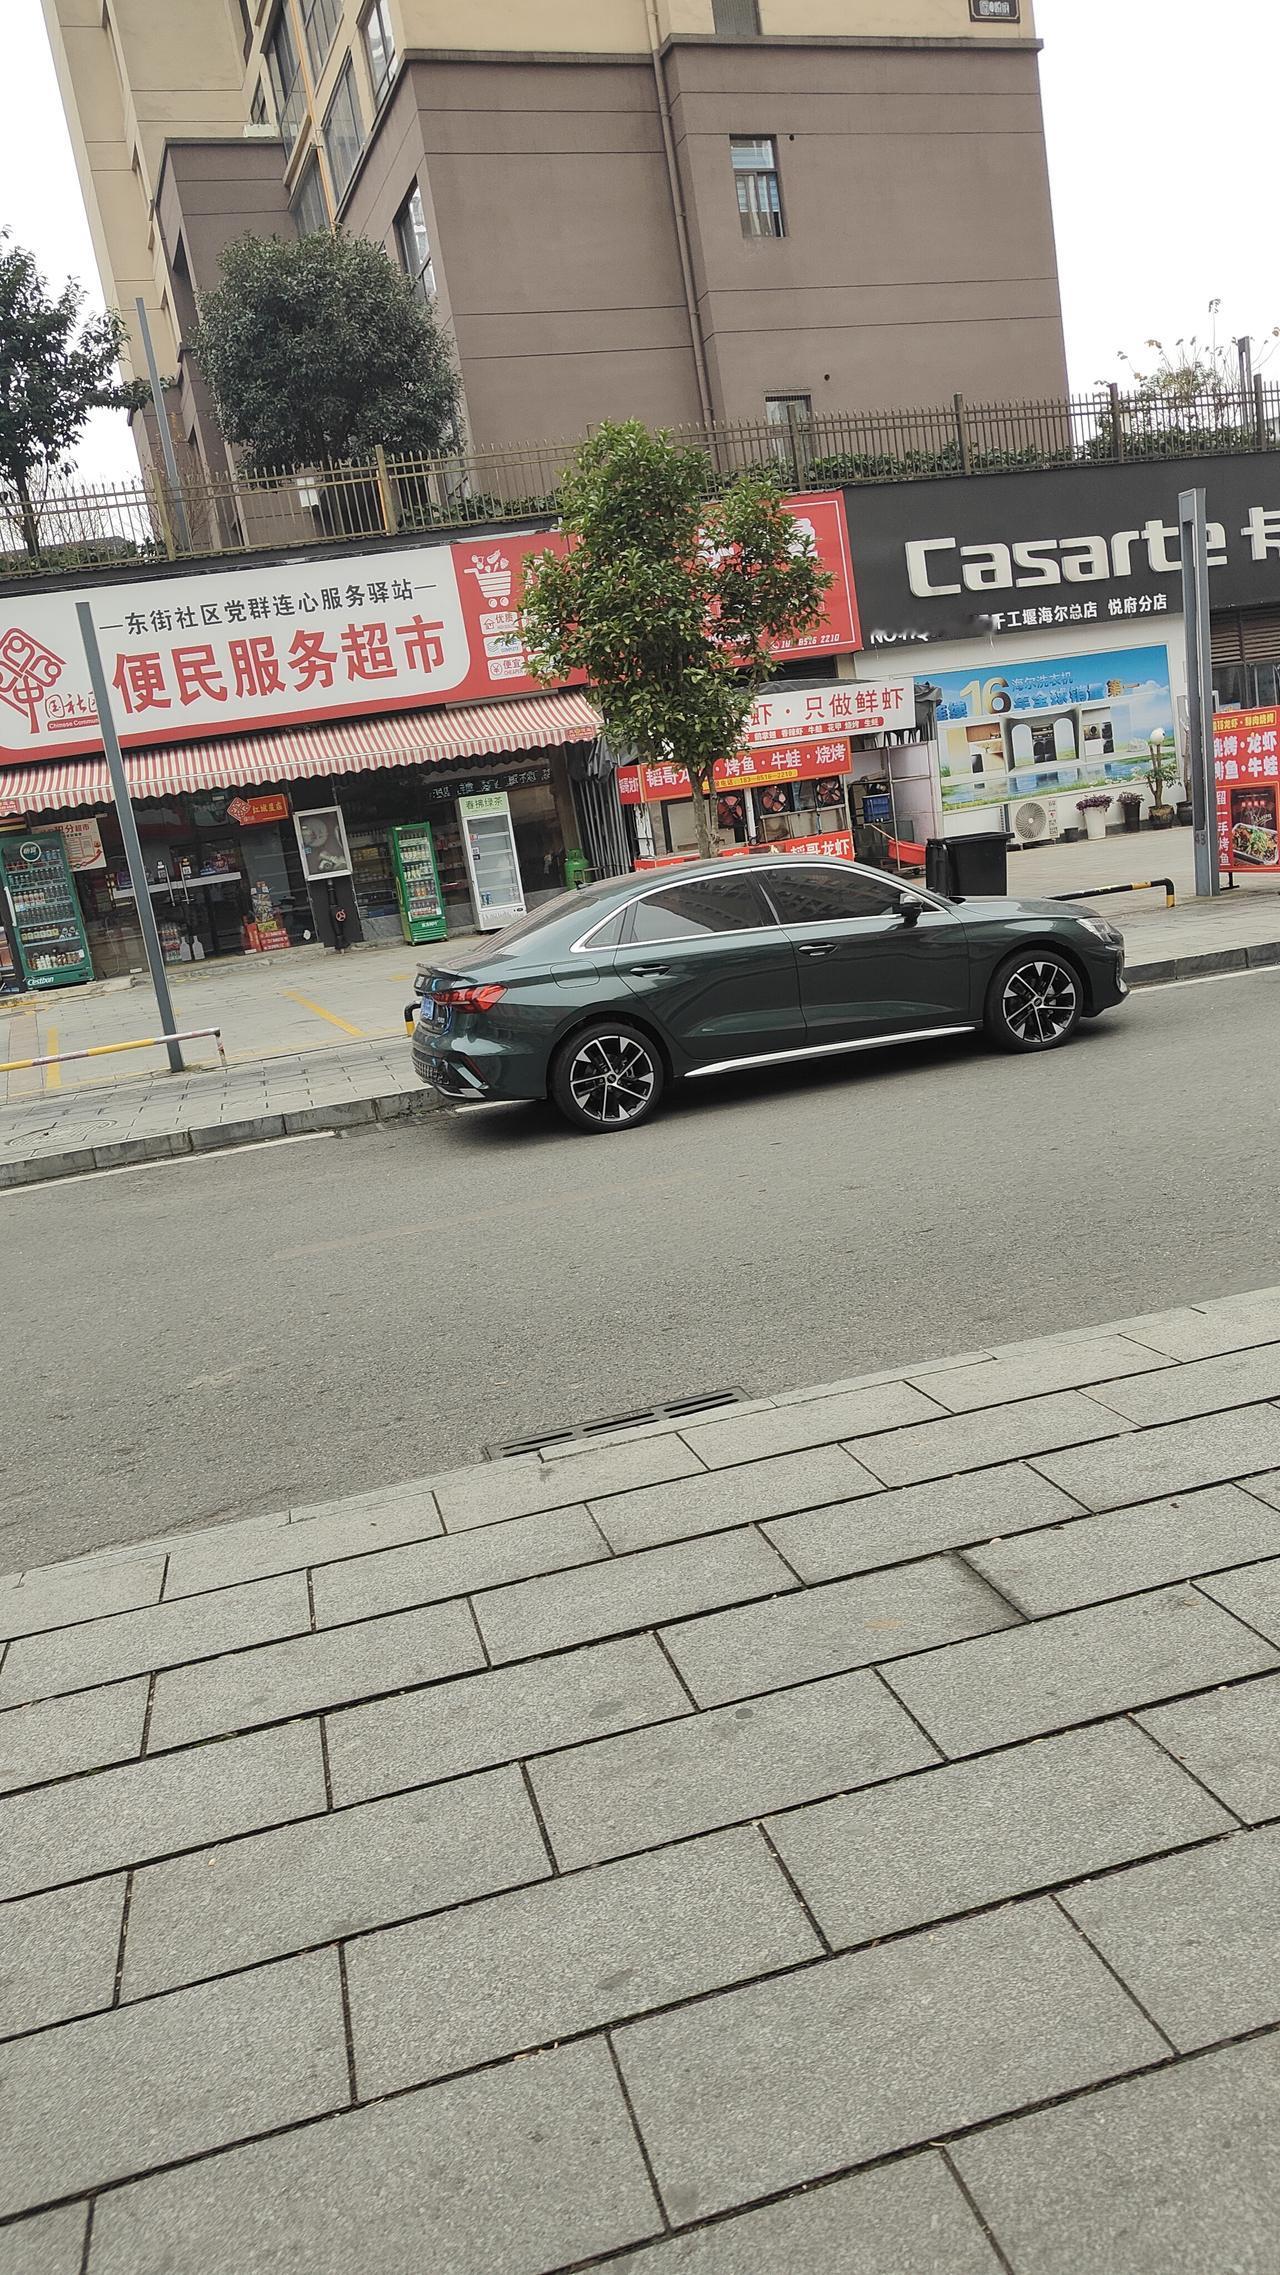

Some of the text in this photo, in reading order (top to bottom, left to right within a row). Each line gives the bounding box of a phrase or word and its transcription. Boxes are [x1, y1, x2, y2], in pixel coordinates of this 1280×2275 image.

[905, 519, 1228, 598] Casarte
[1108, 593, 1167, 616] 悦府分店
[820, 633, 840, 643] 2210
[112, 614, 445, 715] 便民服务超市
[960, 677, 1012, 716] 16
[827, 721, 842, 732] 花甲
